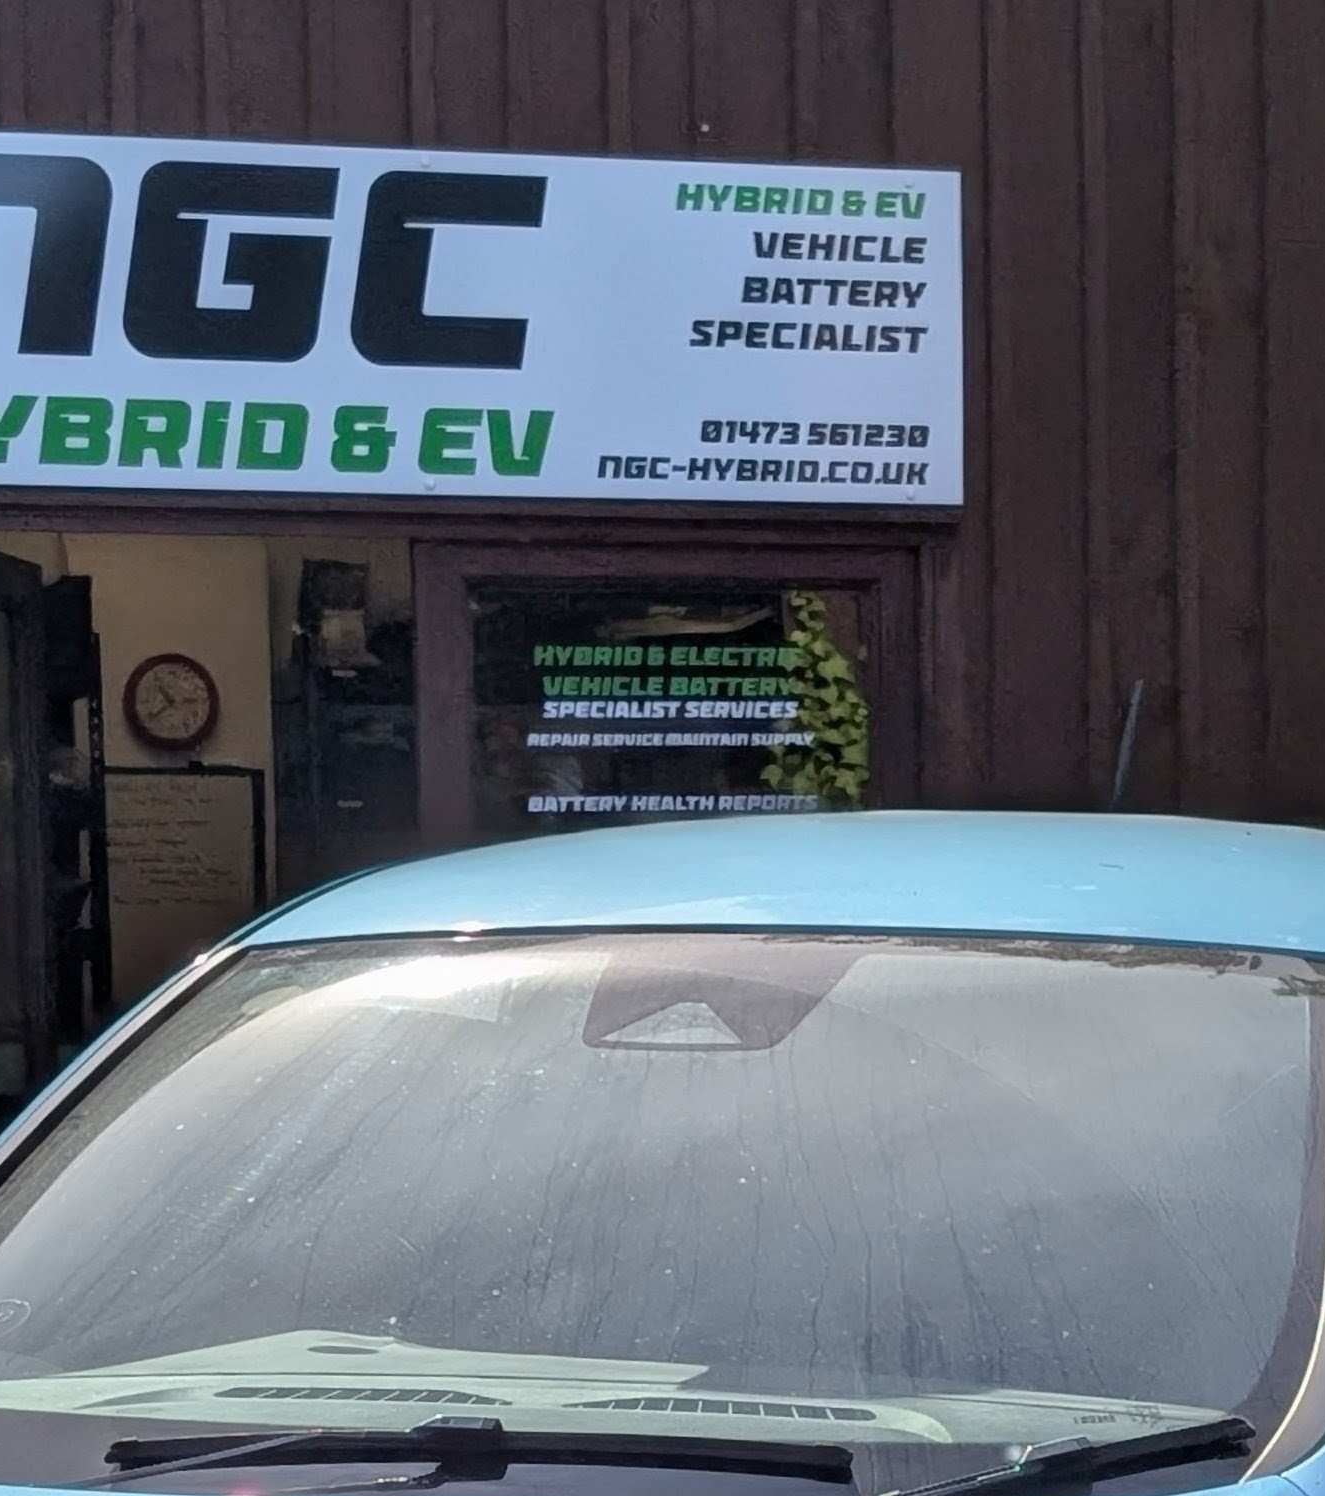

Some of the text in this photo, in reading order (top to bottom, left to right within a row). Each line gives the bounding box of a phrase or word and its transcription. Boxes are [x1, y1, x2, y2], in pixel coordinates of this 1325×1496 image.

[674, 182, 927, 220] HYBRID & EV
[753, 231, 928, 265] VEHICLE
[741, 276, 928, 309] BATTERY
[689, 319, 929, 354] SPECIALIST
[330, 404, 398, 474] &
[416, 406, 555, 478] EV
[699, 419, 931, 449] 01473 561230
[596, 454, 930, 486] NGC-HYBRID.CO.UK
[533, 645, 645, 667] HYBRID
[541, 675, 795, 698] VEHICLE BATTERY
[542, 700, 801, 720] SPECIALIST SERVICES
[527, 732, 591, 747] REPAIR
[591, 733, 665, 747] SERVICE
[527, 795, 819, 813] BATTERY HEALTH REPORTS
